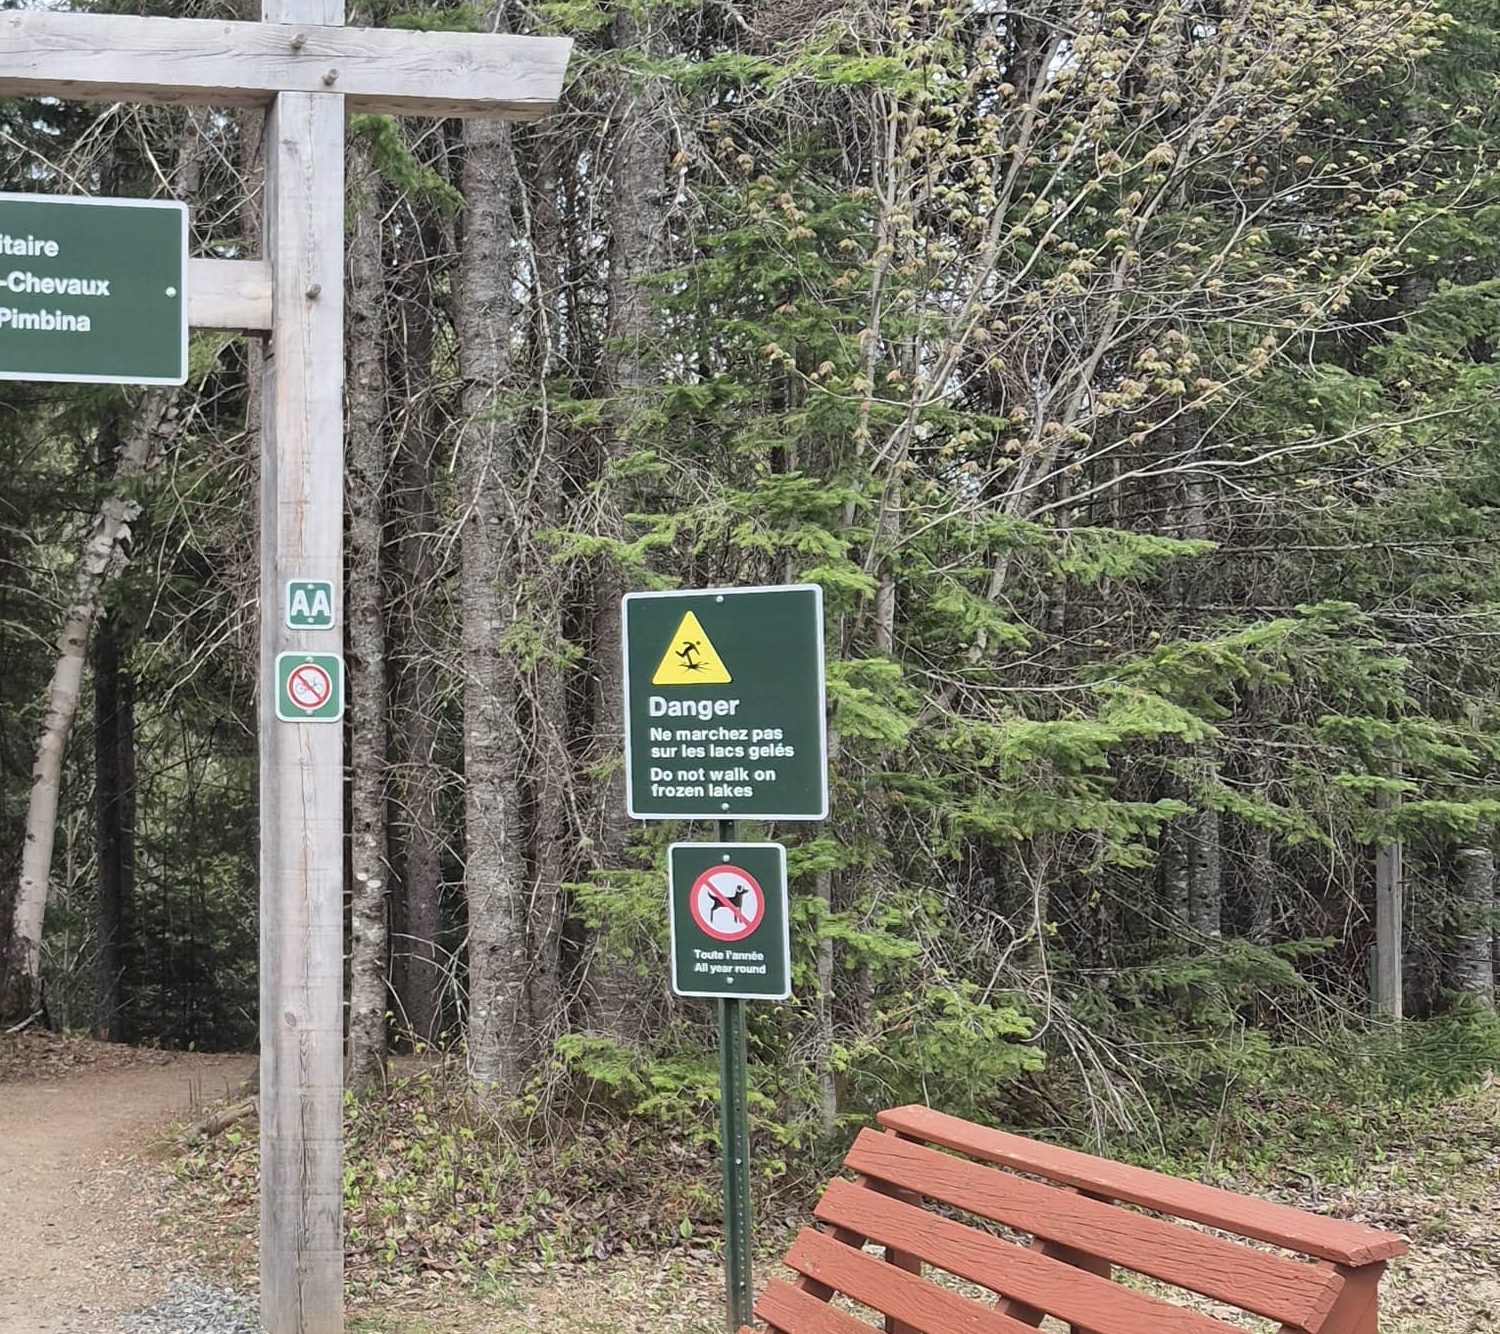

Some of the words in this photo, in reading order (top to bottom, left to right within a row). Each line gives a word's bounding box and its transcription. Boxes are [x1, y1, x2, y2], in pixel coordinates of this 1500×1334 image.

[290, 589, 331, 617] AA
[649, 696, 740, 720] Danger
[650, 727, 672, 741] Ne
[676, 727, 748, 742] marchez
[752, 727, 783, 744] pas
[651, 745, 676, 758] sur
[681, 744, 705, 758] les
[710, 743, 744, 758] lacs
[749, 742, 794, 760] gelés
[650, 767, 673, 782] Do
[678, 768, 705, 782] not
[710, 767, 749, 782] walk
[754, 769, 776, 781] on
[651, 784, 704, 797] frozen
[708, 783, 753, 797] lakes
[694, 949, 724, 960] Toute
[726, 950, 764, 961] l'année
[694, 963, 708, 972] All
[710, 964, 733, 974] year
[735, 964, 766, 974] round
